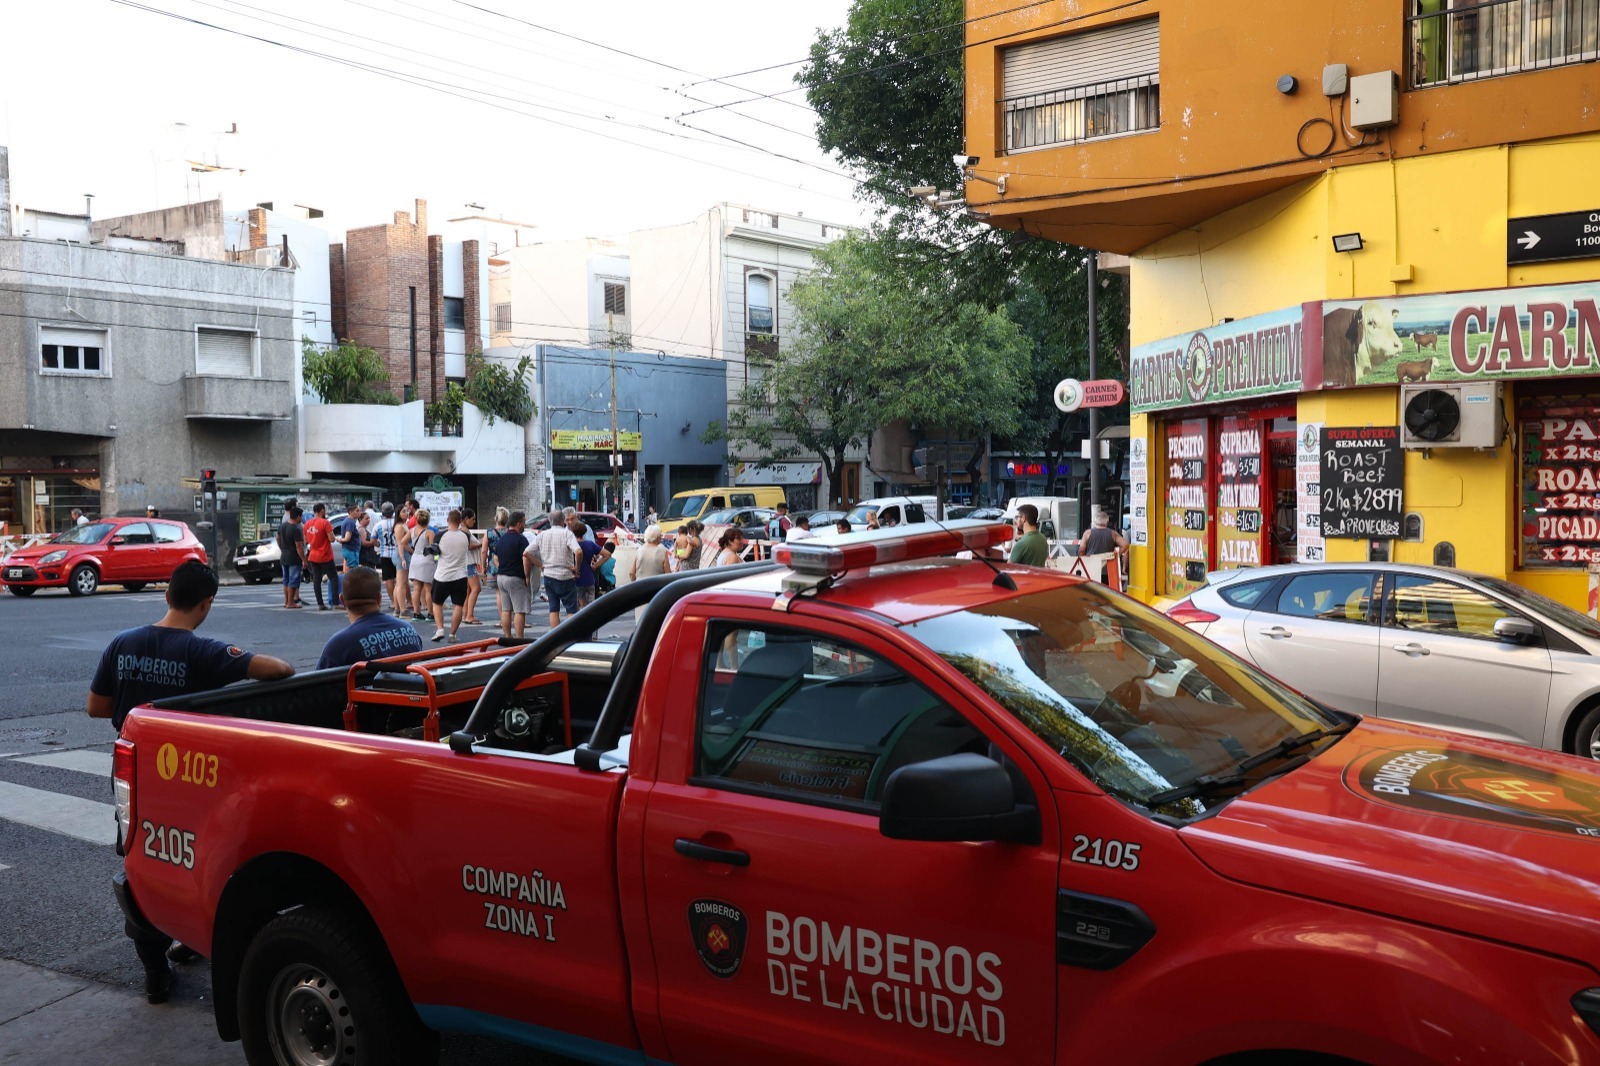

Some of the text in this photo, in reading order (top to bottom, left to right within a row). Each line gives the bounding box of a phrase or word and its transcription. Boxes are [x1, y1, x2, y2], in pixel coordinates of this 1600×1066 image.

[1575, 236, 1600, 247] 1100
[1131, 349, 1184, 407] CARNES
[1212, 323, 1302, 394] PREMIUM
[1085, 385, 1117, 394] CARNES
[1085, 394, 1118, 403] PREMIUM
[1327, 429, 1396, 439] SUPER OFERTA
[1541, 419, 1600, 440] PA
[1168, 435, 1204, 459] PECHITO
[1220, 429, 1260, 455] SUPREMA
[1335, 440, 1386, 448] SEMANAL
[776, 465, 787, 474] pro
[1324, 449, 1391, 471] ROAST
[1306, 474, 1320, 482] CARN
[1340, 467, 1386, 484] Beef
[1169, 485, 1204, 508] COSTILLITA
[1239, 483, 1259, 508] MUSLO
[1237, 510, 1257, 533] $1650
[1538, 517, 1600, 540] PICAD
[1170, 536, 1204, 560] BONDIOLA
[1221, 540, 1259, 564] ALITA
[364, 648, 377, 658] DE
[379, 643, 391, 652] LA
[117, 654, 188, 679] BOMBEROS
[118, 671, 186, 688] DE LA CIUDAD
[181, 750, 219, 788] 103
[1373, 750, 1449, 796] BOMBEROS
[142, 820, 196, 870] 2105
[1071, 834, 1141, 871] 2105
[461, 864, 567, 911] COMPAÑIA
[484, 902, 556, 942] ZONA I
[694, 902, 740, 921] BOMBEROS
[766, 910, 1004, 1001] BOMBEROS
[767, 957, 1007, 1047] DE LA CIUDAD
